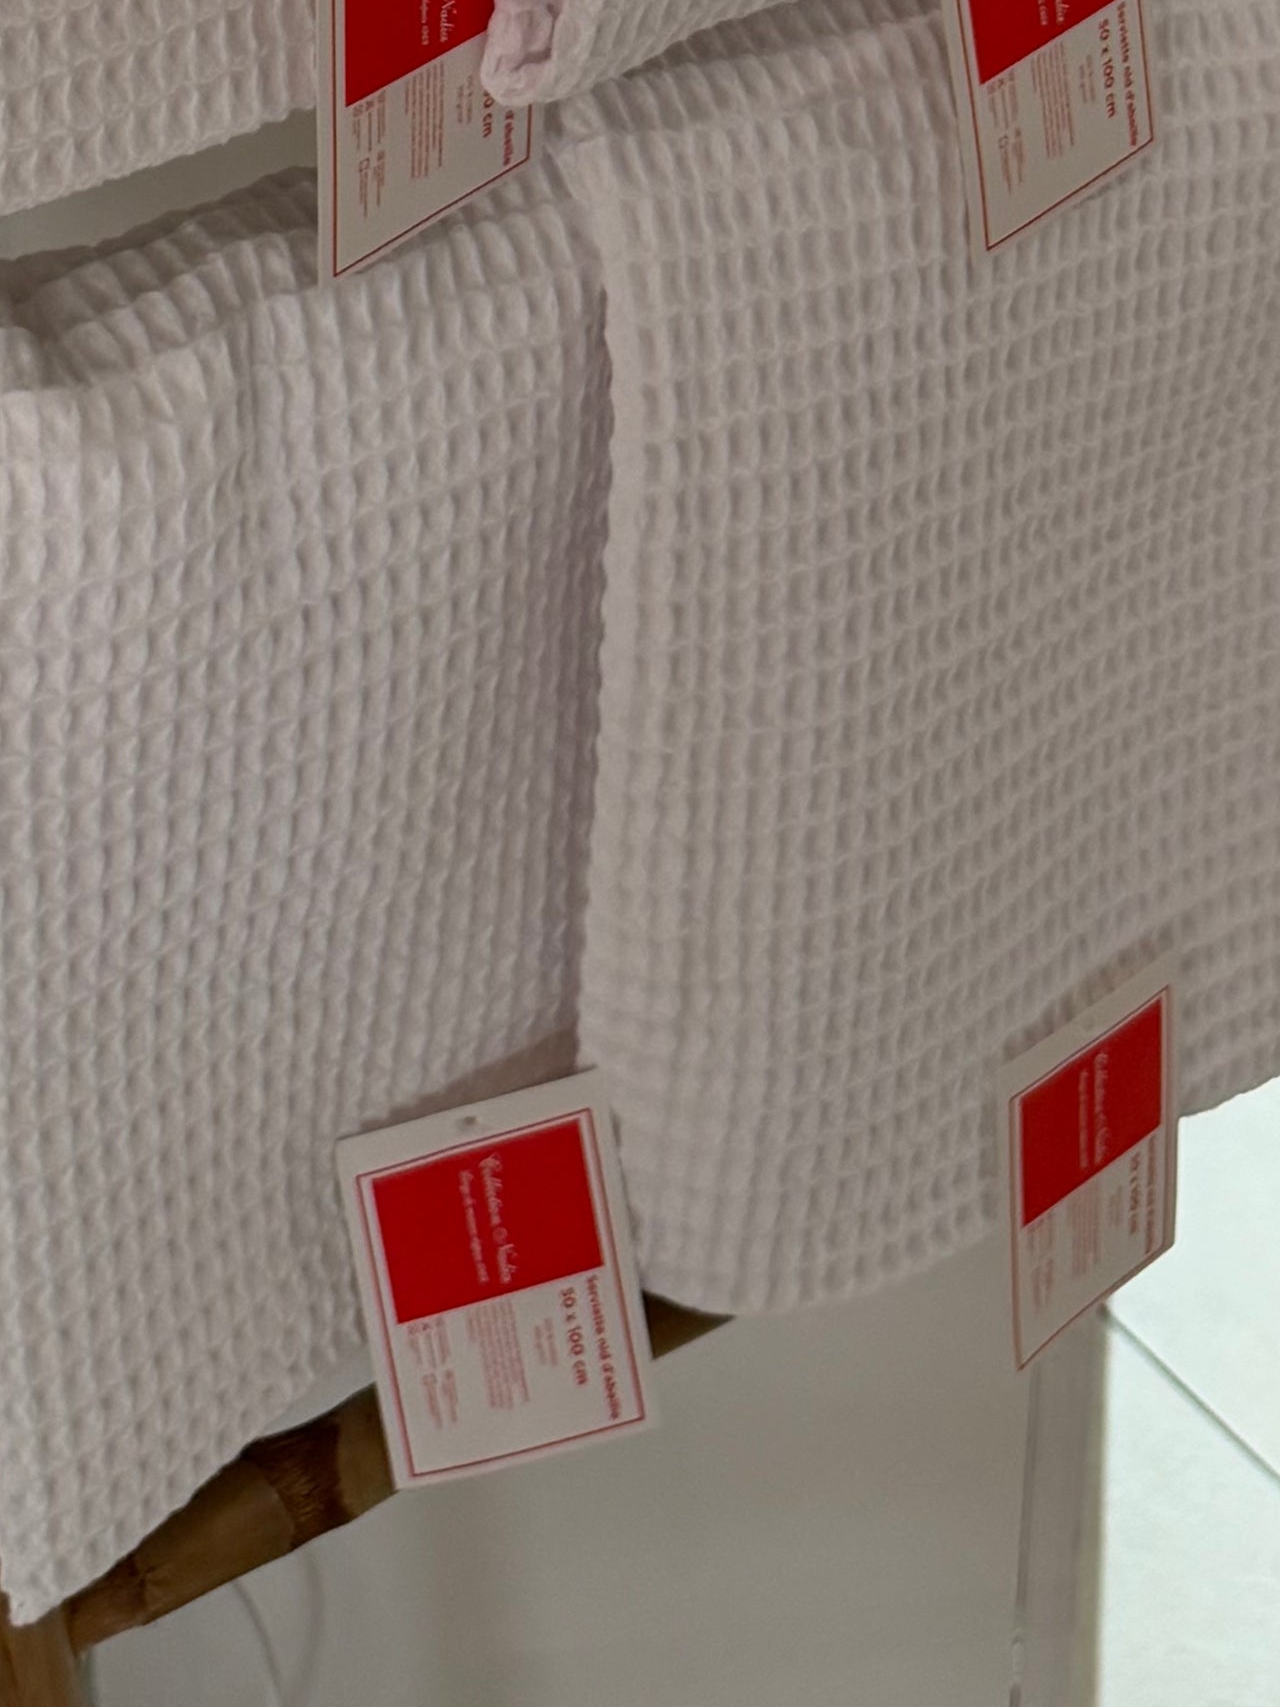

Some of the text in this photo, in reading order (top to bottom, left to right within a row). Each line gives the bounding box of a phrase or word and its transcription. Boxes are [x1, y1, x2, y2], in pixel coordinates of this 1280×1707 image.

[1102, 58, 1115, 89] 100
[1105, 92, 1117, 119] cm
[482, 112, 493, 138] cm
